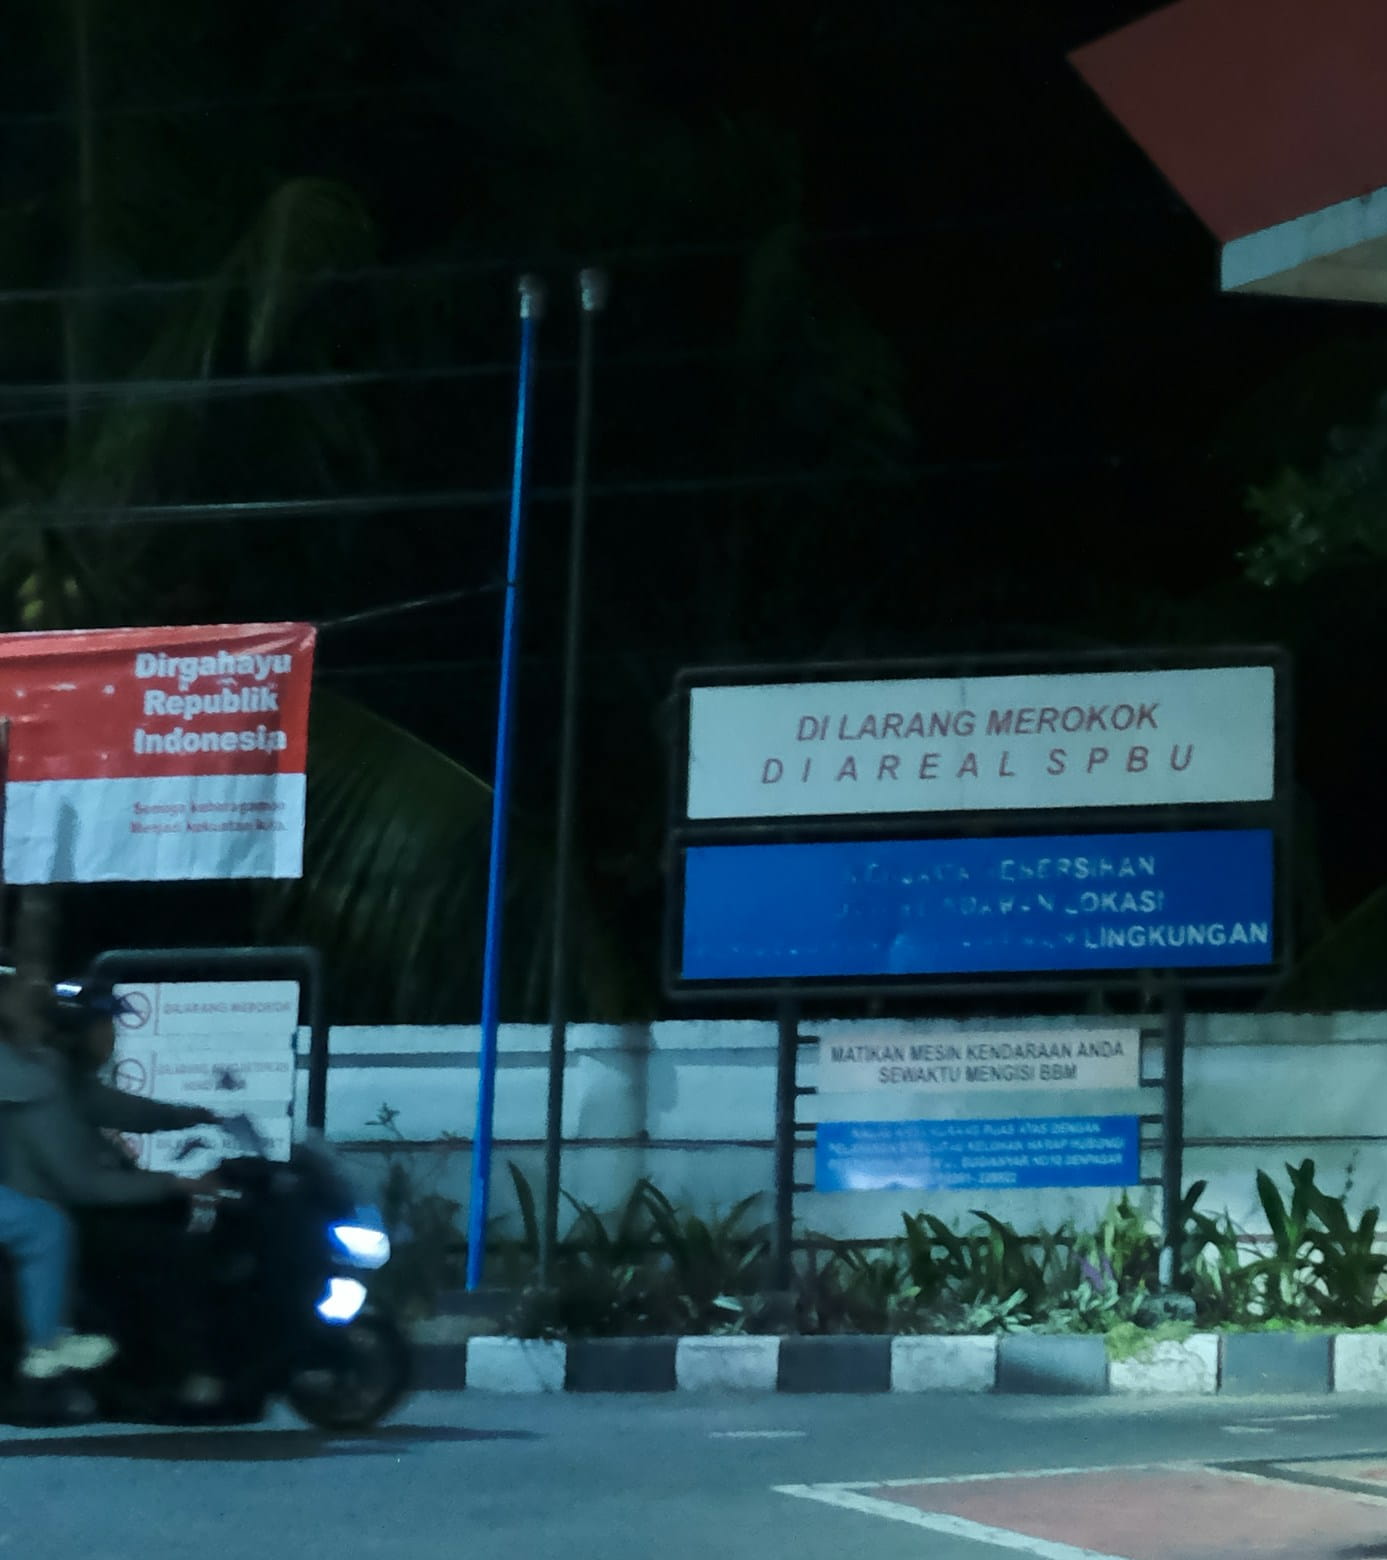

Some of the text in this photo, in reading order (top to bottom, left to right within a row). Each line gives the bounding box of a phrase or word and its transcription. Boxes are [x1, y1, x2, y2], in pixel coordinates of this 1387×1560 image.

[135, 650, 292, 691] Dirgahayu
[144, 686, 278, 720] Republik
[797, 702, 1161, 741] DI LARANG MEROKOK
[133, 725, 288, 754] Indonesia
[988, 855, 1155, 884] EBERSIHAN
[1084, 922, 1268, 949] LINGKUNGAN
[830, 1040, 1124, 1063] MATIKAN MESIN KENDARAAN ANDA
[879, 1063, 1078, 1084] SEWAKTU MENGISI BBM
